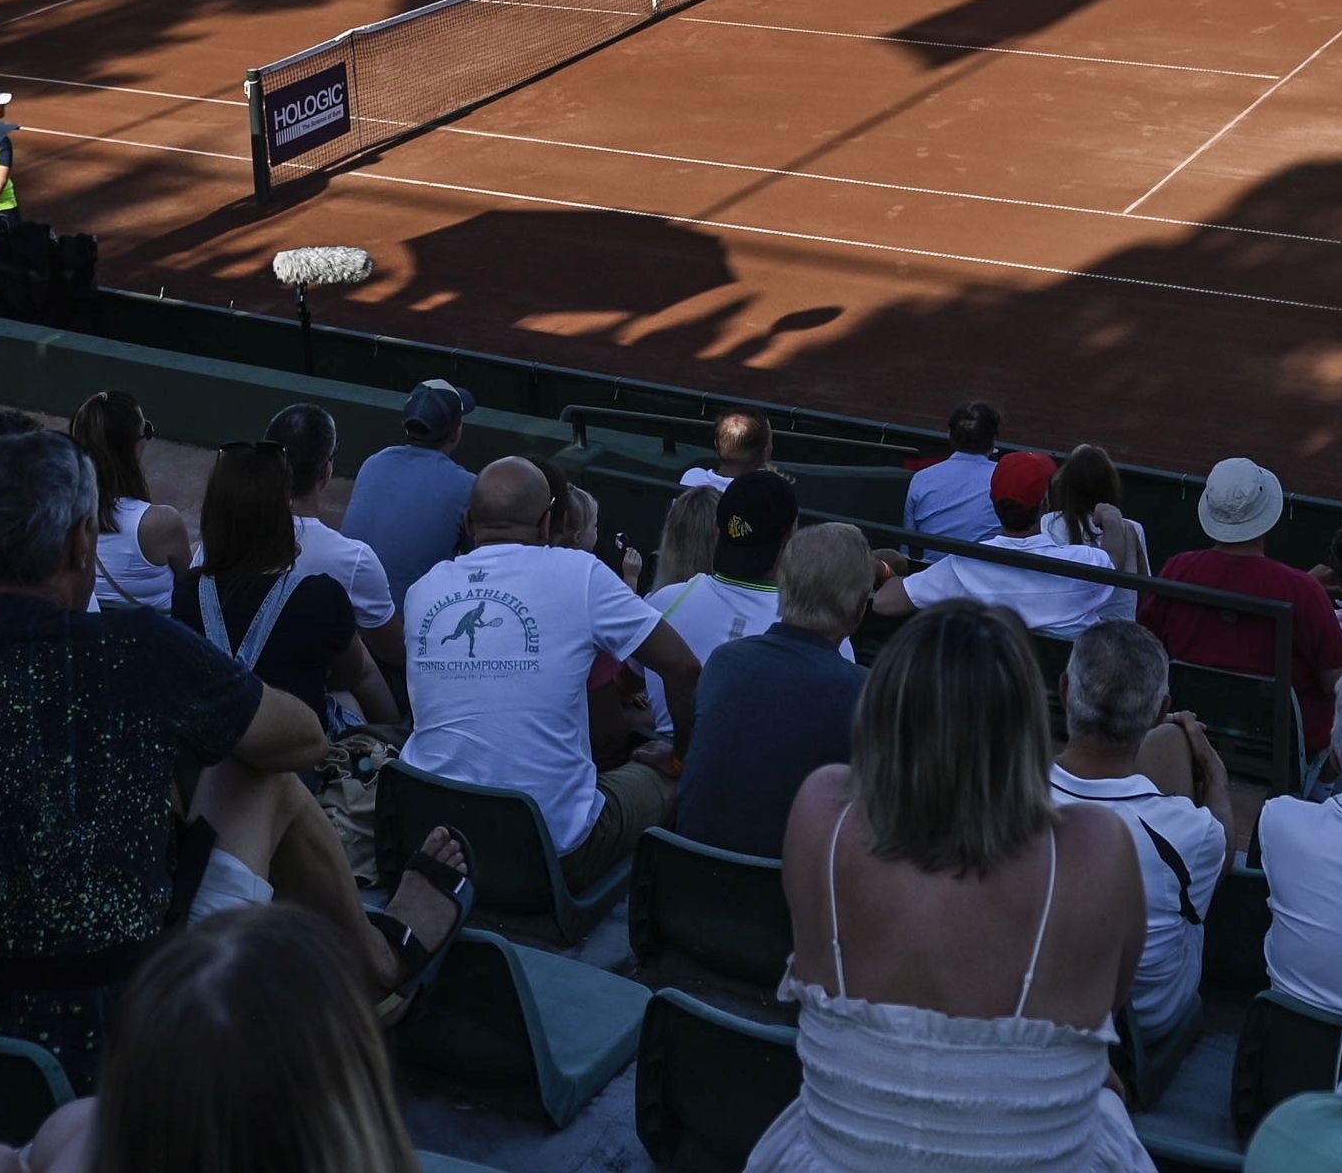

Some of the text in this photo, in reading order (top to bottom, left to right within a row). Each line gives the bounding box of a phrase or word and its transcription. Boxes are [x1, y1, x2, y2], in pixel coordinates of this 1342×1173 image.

[274, 83, 344, 130] HOLOGIC
[465, 588, 530, 617] ATHLETIC
[526, 616, 540, 654] CLUB
[418, 660, 539, 672] TENNIS CHAMPIONSHIPS
